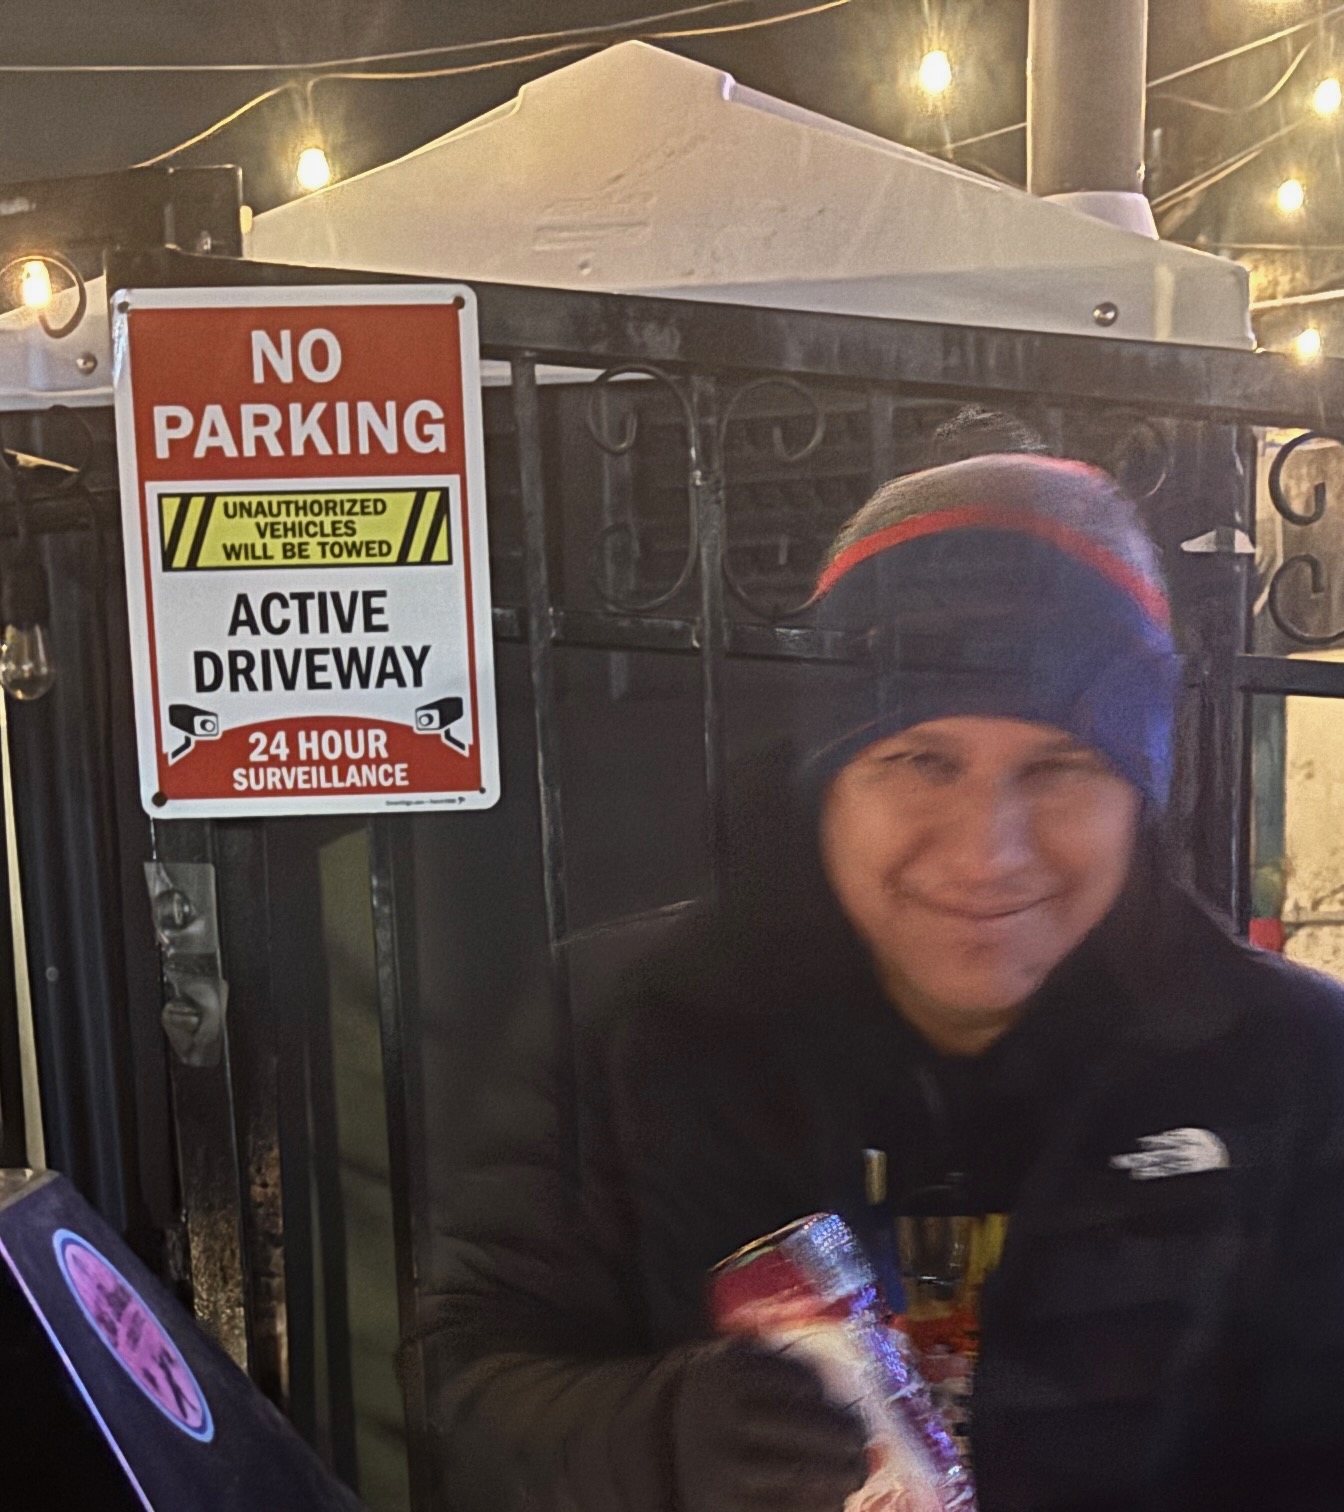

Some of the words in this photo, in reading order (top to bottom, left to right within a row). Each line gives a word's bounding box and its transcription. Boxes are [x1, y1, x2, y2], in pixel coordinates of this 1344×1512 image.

[252, 329, 342, 384] NO
[153, 400, 446, 459] PARKING
[223, 498, 387, 519] UNAUTHORIZED
[255, 519, 356, 538] VEHICLES
[223, 542, 275, 560] WILL
[281, 542, 311, 559] BE
[317, 539, 392, 559] TOWED
[228, 589, 389, 636] ACTIVE
[193, 645, 431, 692] DRIVEWAY
[248, 732, 292, 761] 24
[299, 729, 388, 759] HOUR
[232, 763, 409, 790] SURVEILLANCE
